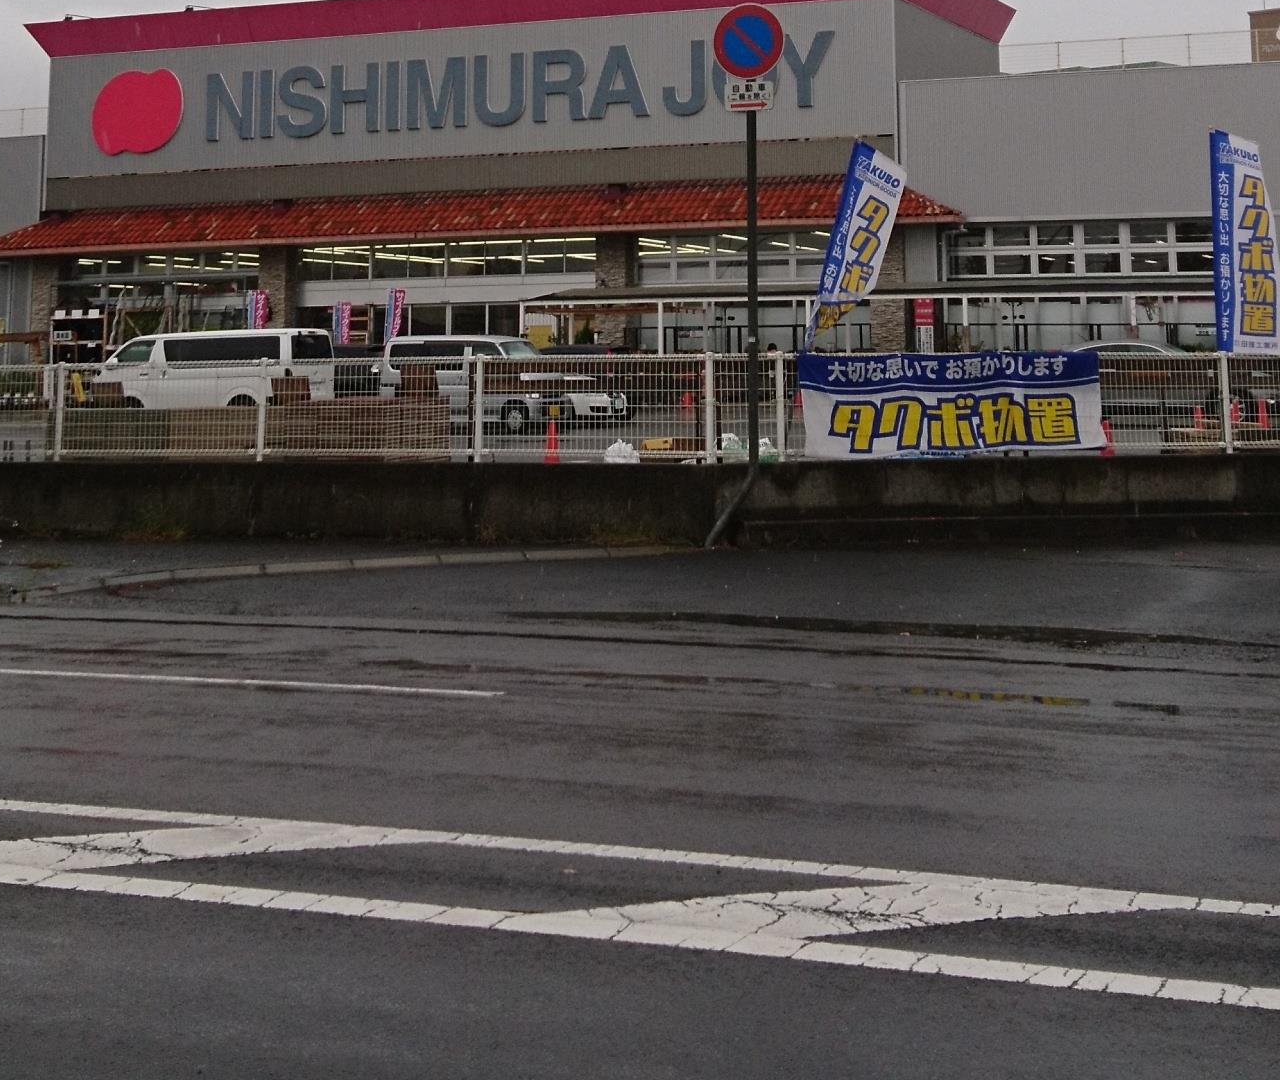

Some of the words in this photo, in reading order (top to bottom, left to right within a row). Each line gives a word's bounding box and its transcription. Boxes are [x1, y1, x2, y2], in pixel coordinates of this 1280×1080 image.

[204, 43, 651, 142] NISHIMURA
[664, 29, 836, 116] JY
[732, 83, 766, 93] 自動車
[858, 156, 901, 189] TAKUBO
[1218, 142, 1260, 165] TAKUBO
[1218, 170, 1230, 248] 大切な思い出
[1237, 173, 1277, 338] タクボ物置
[1219, 253, 1231, 342] お預かりします
[827, 356, 939, 384] 大切な思いで
[944, 354, 1069, 380] お預かりします
[828, 392, 1082, 455] タクボ物置
